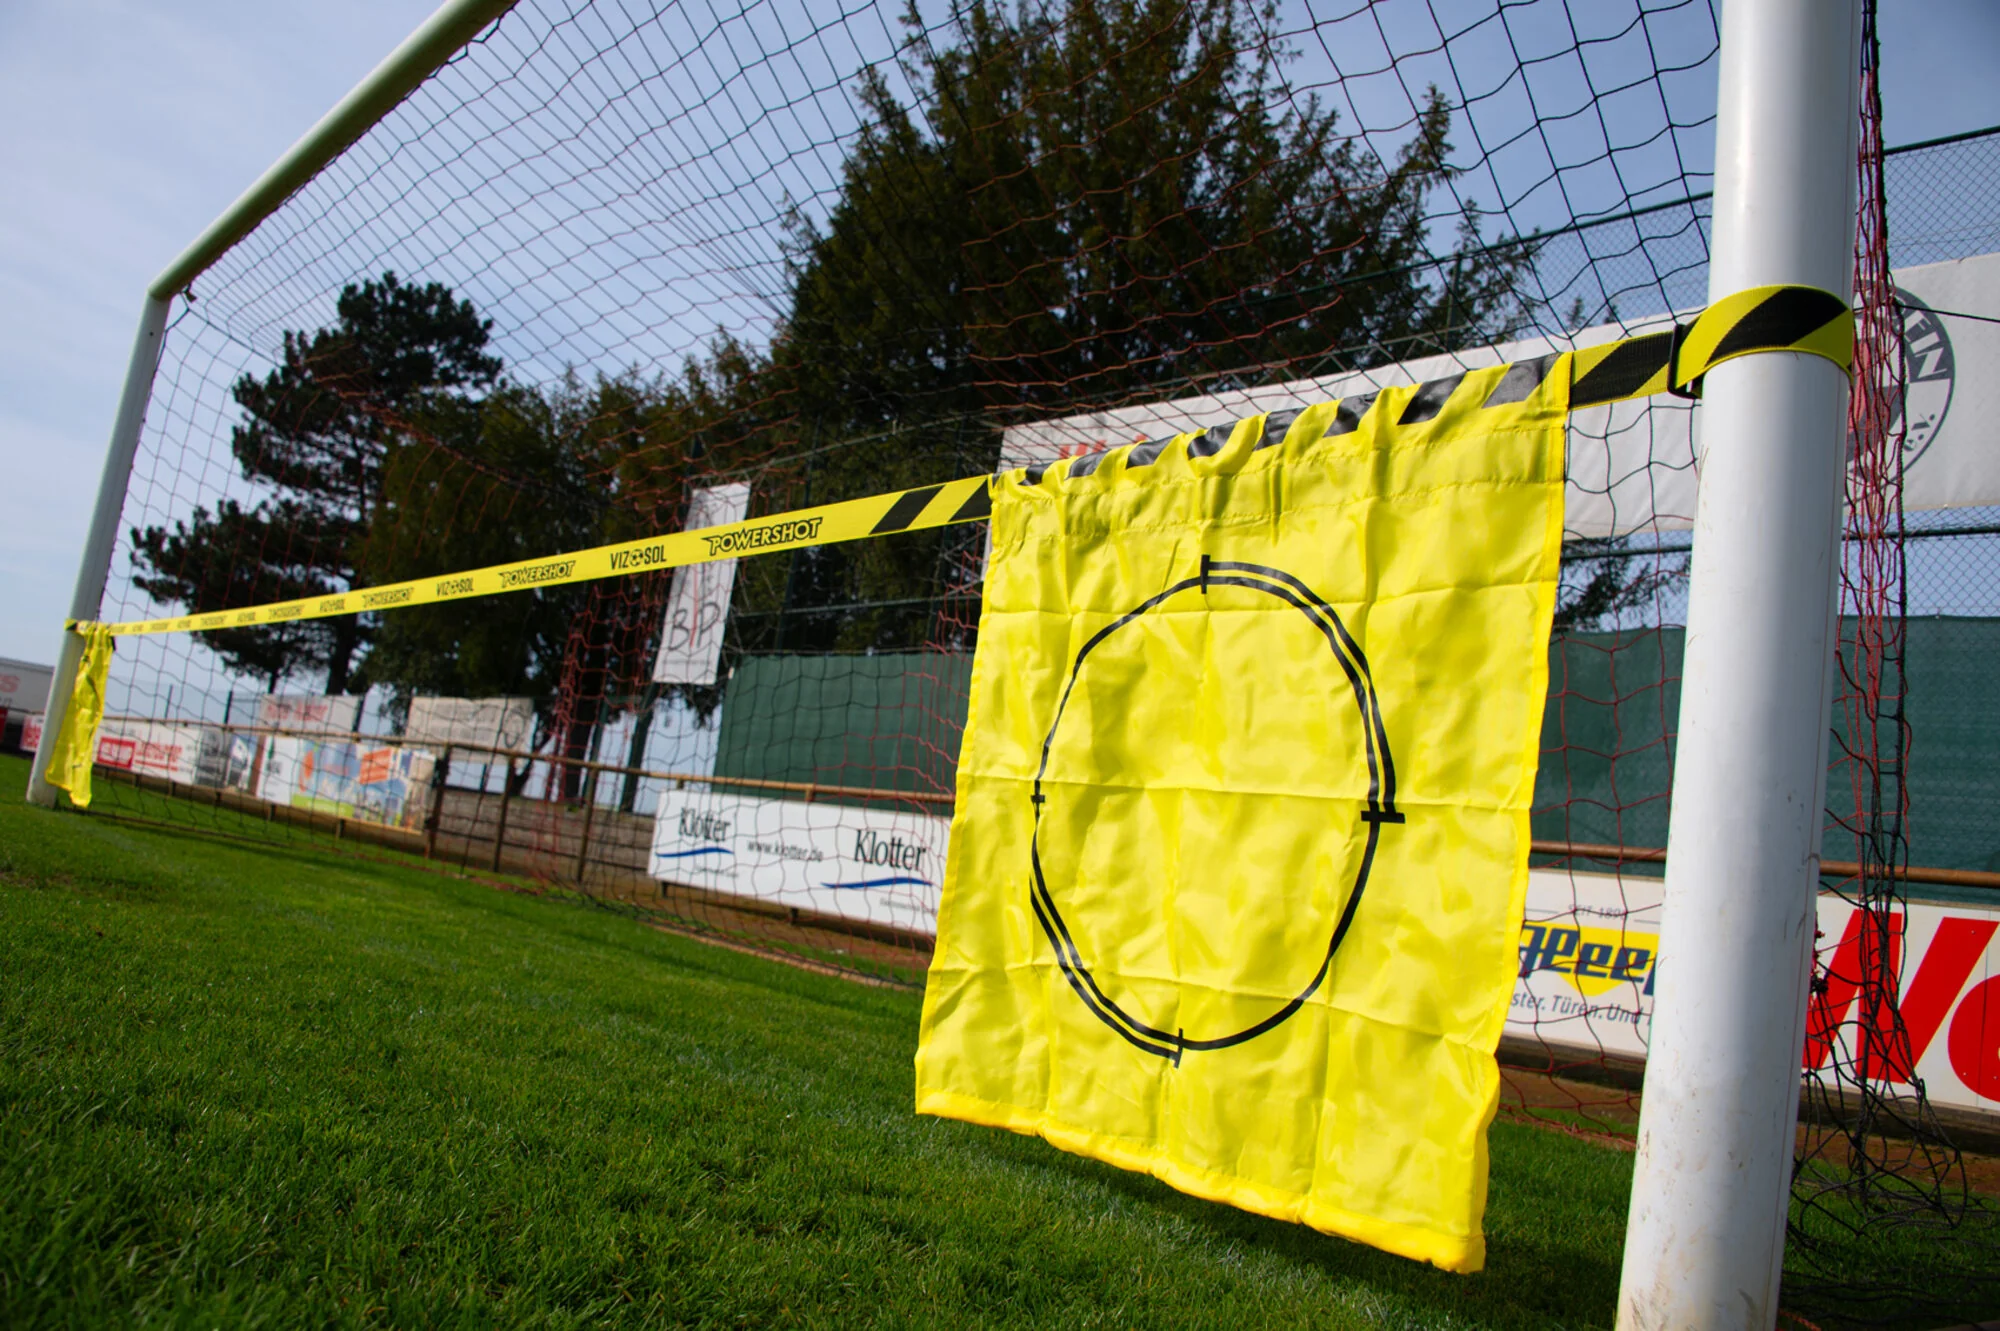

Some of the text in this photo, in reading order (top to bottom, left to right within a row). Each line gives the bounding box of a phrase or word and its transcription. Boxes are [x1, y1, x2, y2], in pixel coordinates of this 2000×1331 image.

[498, 559, 576, 588] POWERSHOT
[701, 517, 823, 556] POWERSHOT
[679, 807, 731, 842] Klotter
[854, 829, 927, 872] Klotter
[1551, 994, 1602, 1020] Türen.
[1606, 1002, 1644, 1024] Und
